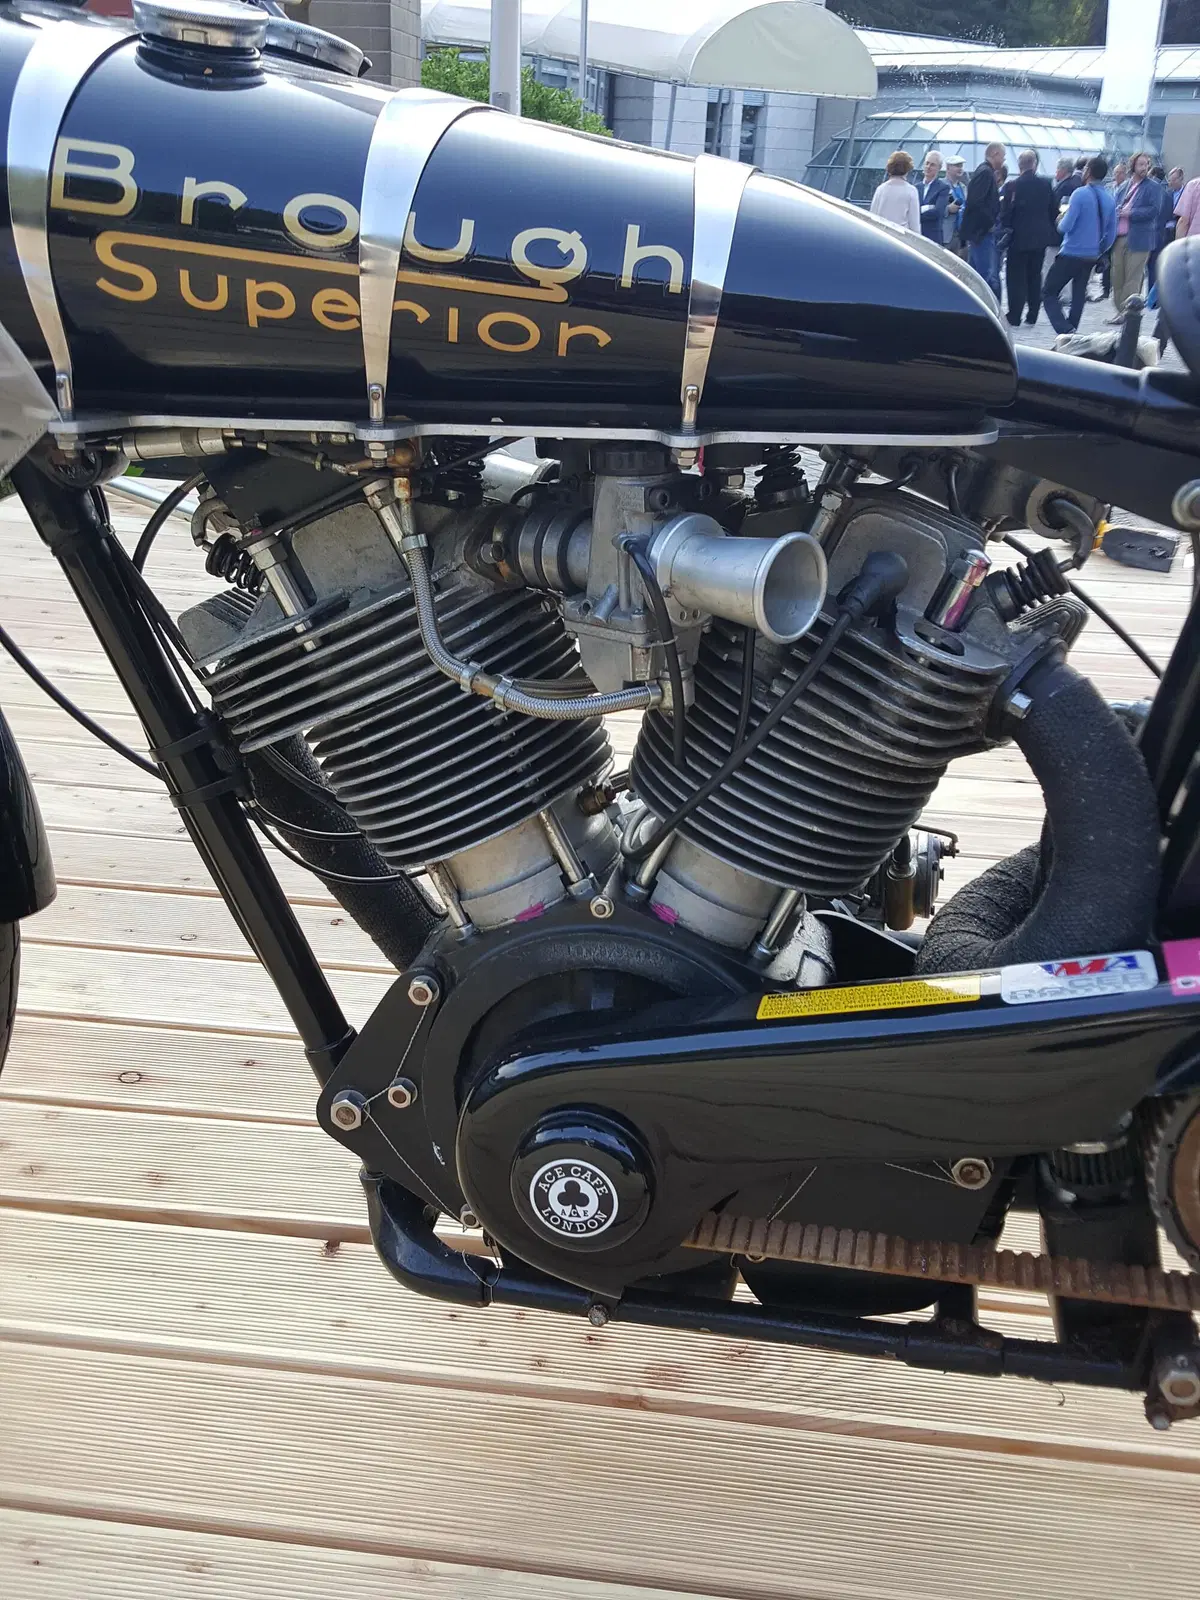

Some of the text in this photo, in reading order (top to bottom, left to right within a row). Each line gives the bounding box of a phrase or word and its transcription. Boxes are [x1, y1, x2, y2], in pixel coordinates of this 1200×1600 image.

[50, 136, 685, 296] Brough
[538, 1166, 609, 1196] ACE CAFE
[541, 1207, 608, 1232] LONDON
[560, 1208, 589, 1217] ACE
